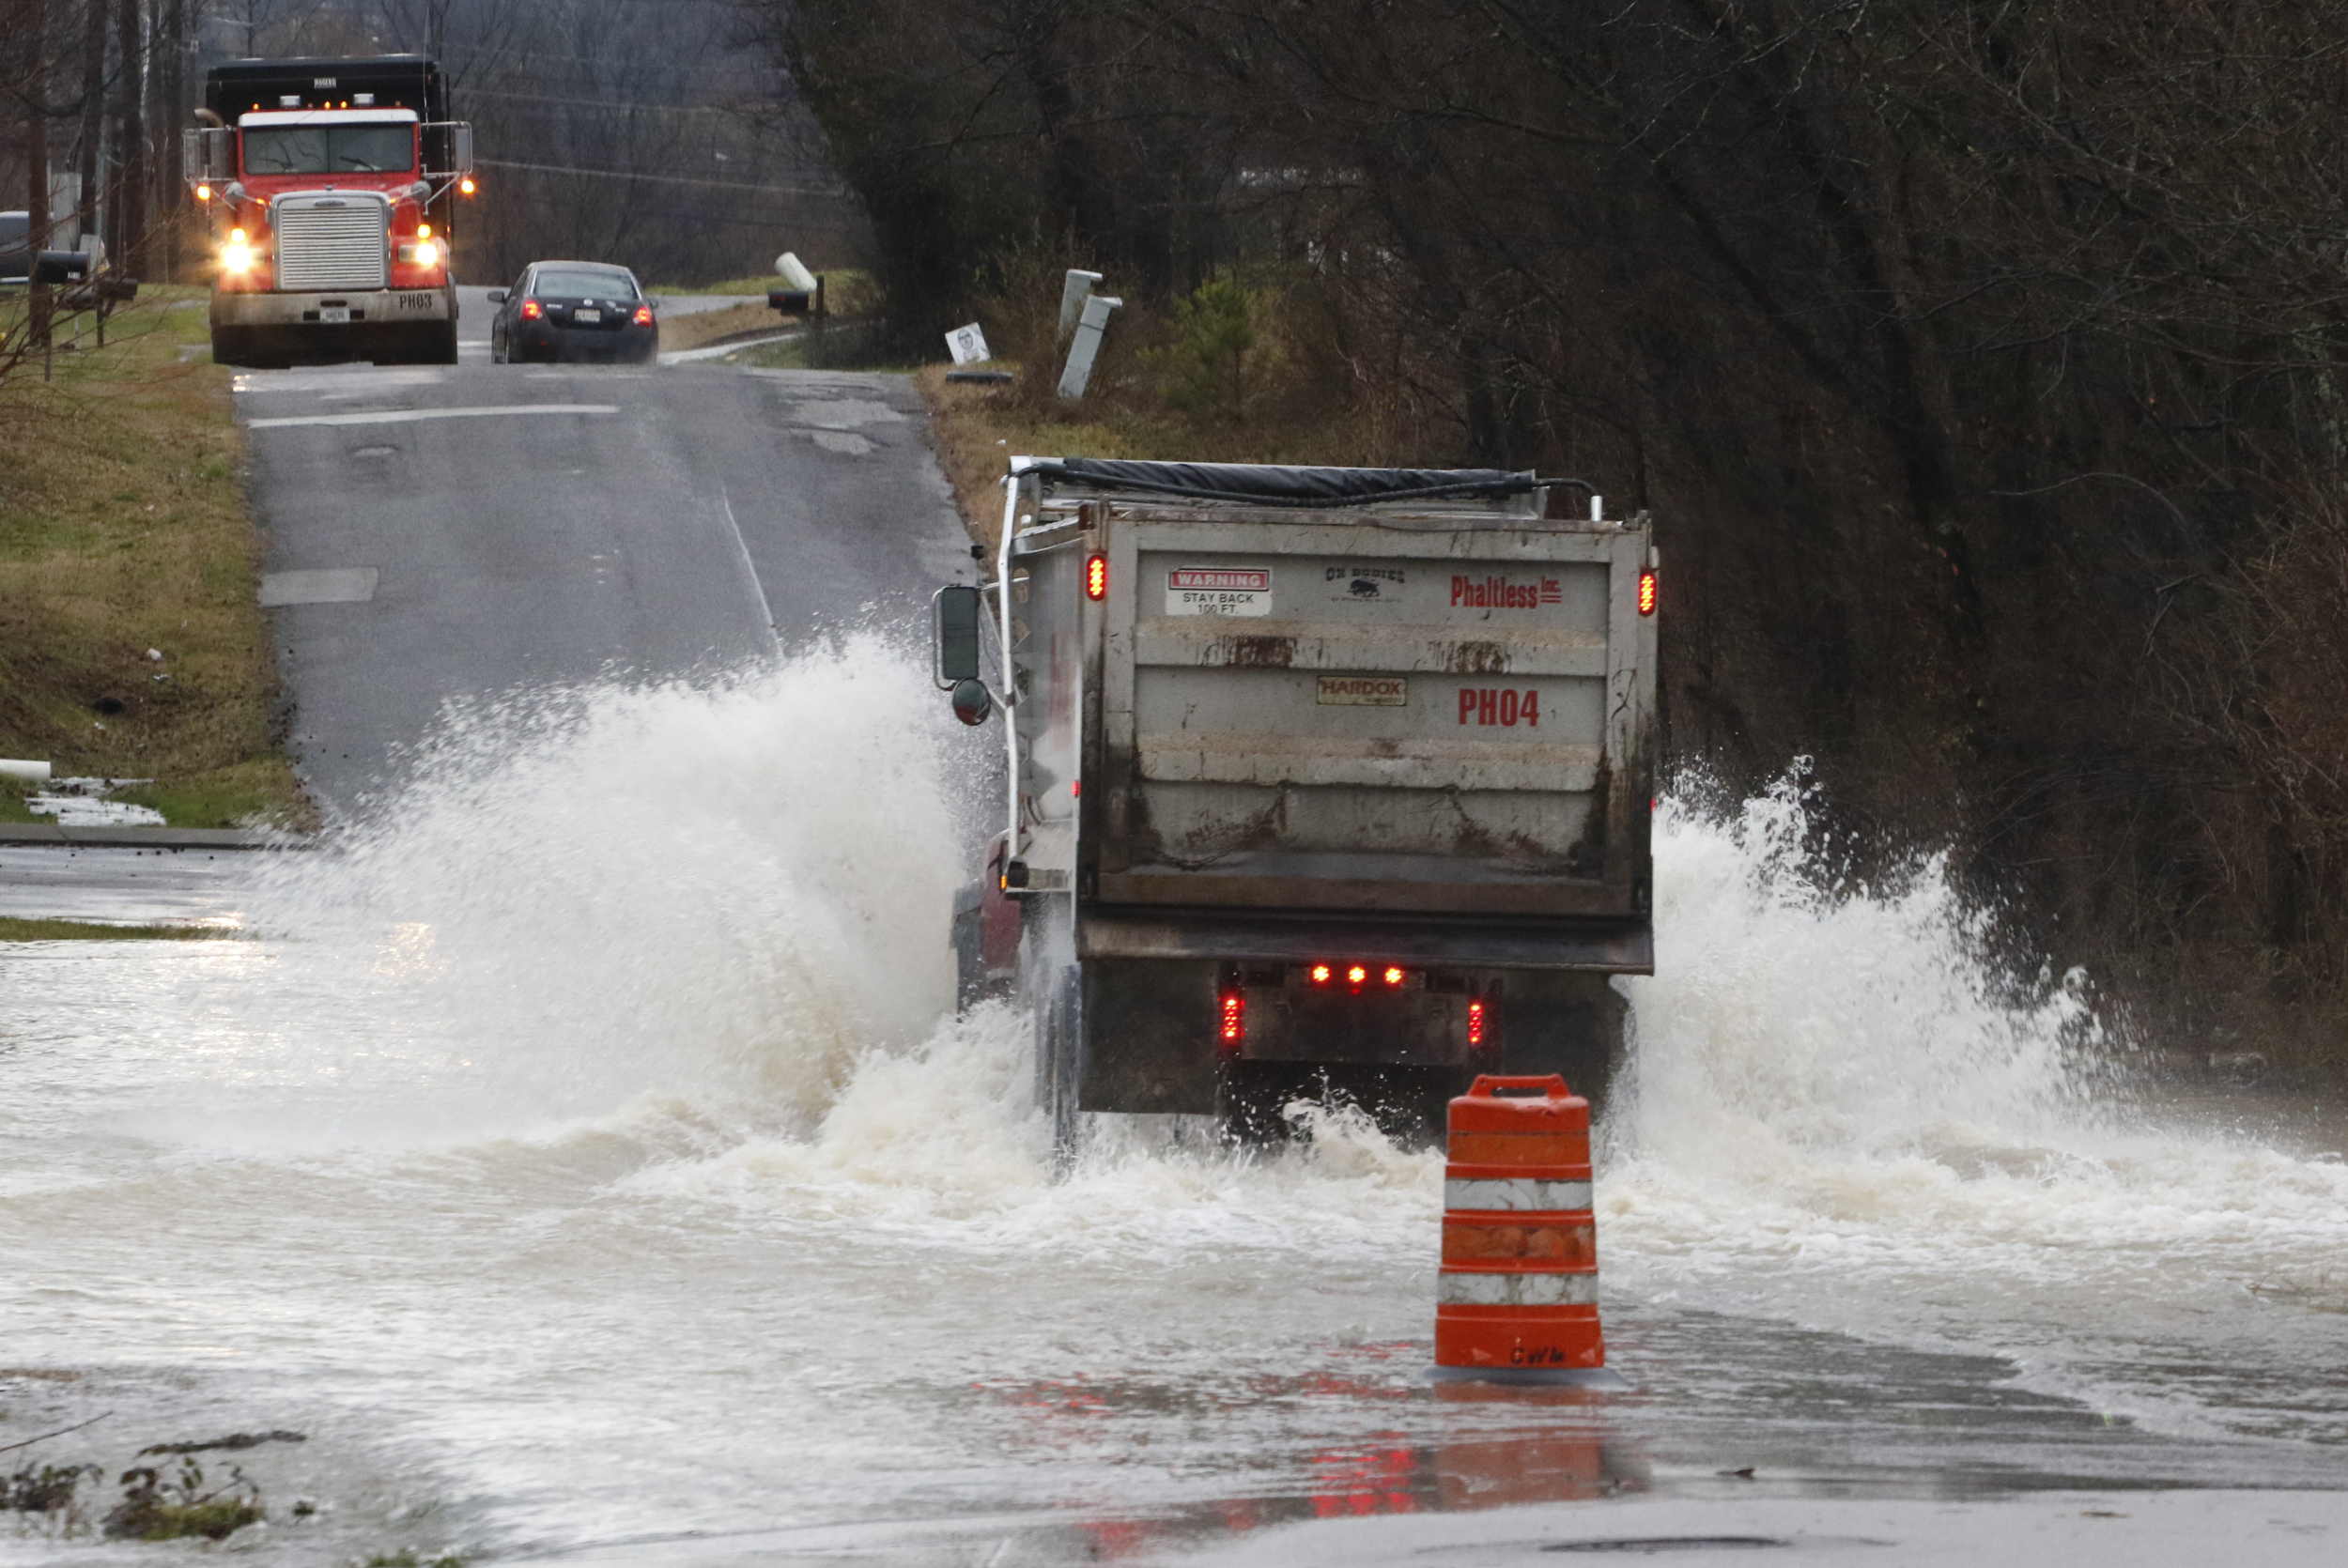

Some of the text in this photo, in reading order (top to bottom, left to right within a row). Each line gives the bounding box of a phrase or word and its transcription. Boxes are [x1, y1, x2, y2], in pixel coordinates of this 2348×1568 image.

[399, 294, 432, 308] PH03
[1177, 573, 1261, 587] WARNING
[1183, 592, 1254, 604] STAY BACK
[1450, 576, 1538, 608] Phaltless
[1198, 604, 1239, 614] 100 FT.
[1321, 681, 1401, 695] HARDOX
[1459, 688, 1539, 727] PH04
